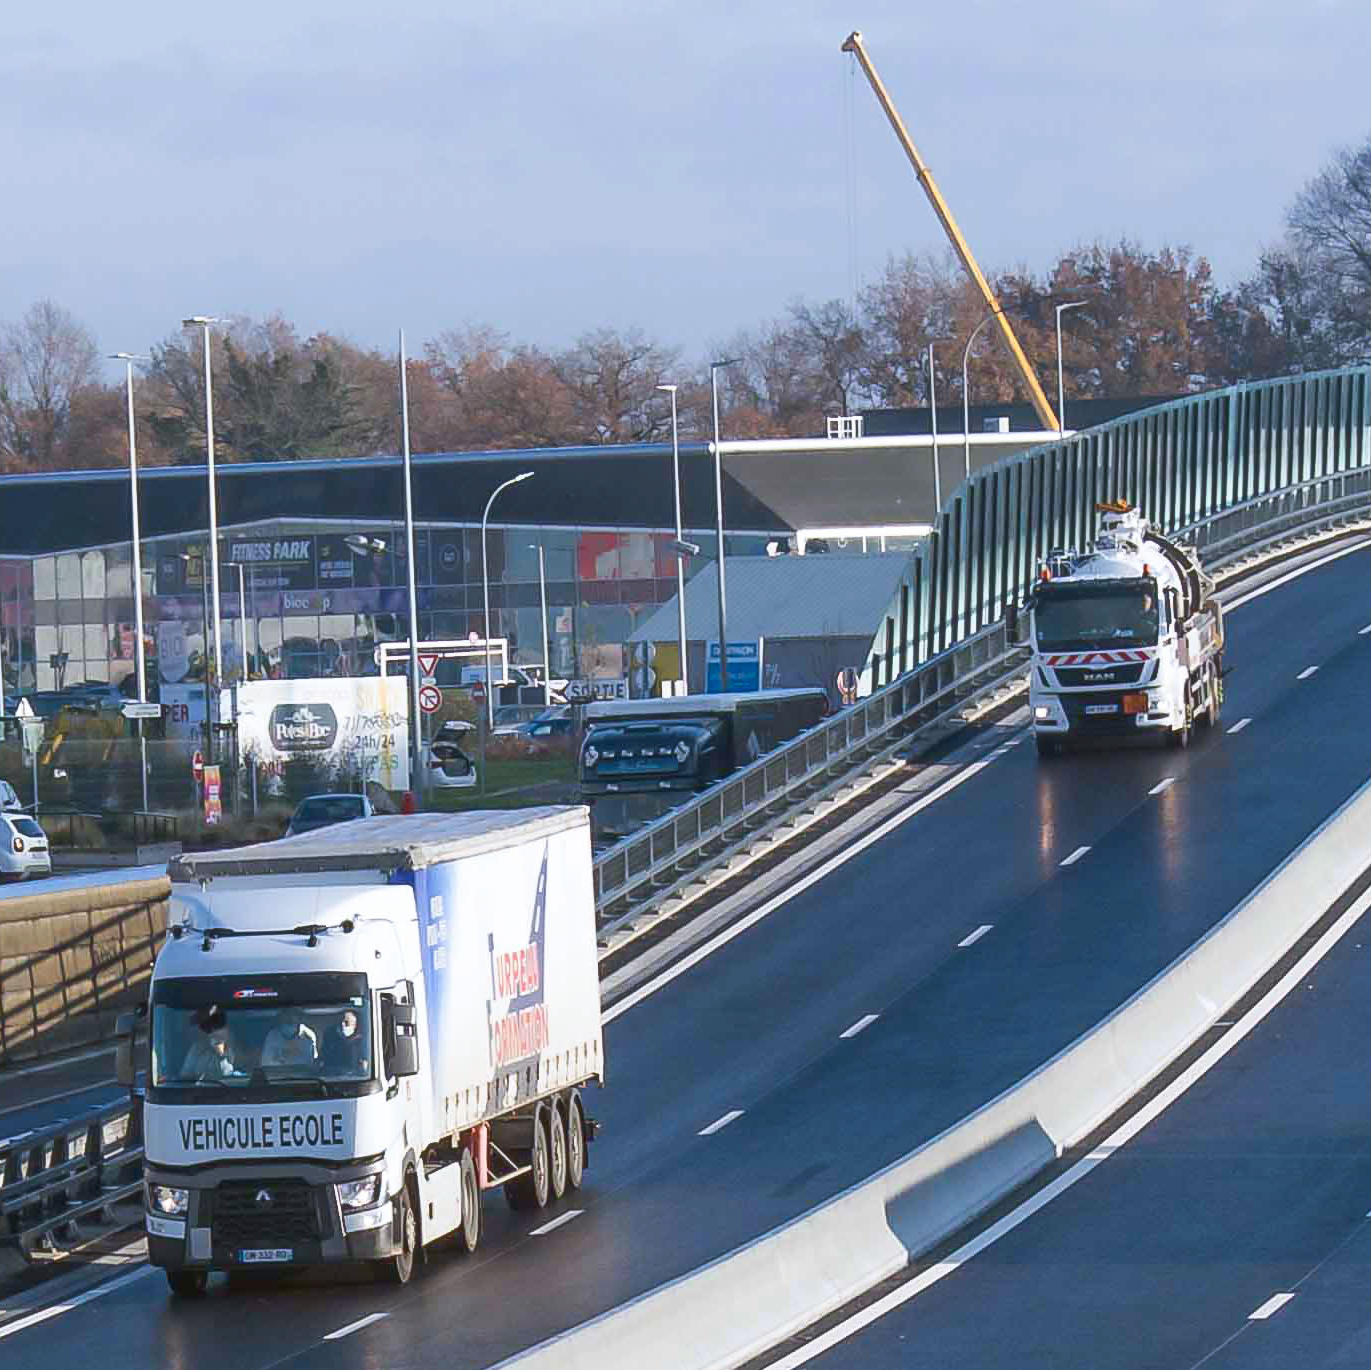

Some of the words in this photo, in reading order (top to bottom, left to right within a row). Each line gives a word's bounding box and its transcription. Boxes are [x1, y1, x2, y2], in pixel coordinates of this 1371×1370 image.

[232, 543, 271, 560] FITNESS
[273, 540, 310, 559] PARK
[179, 1115, 274, 1151] VEHICULE
[278, 1113, 344, 1147] ECOLE
